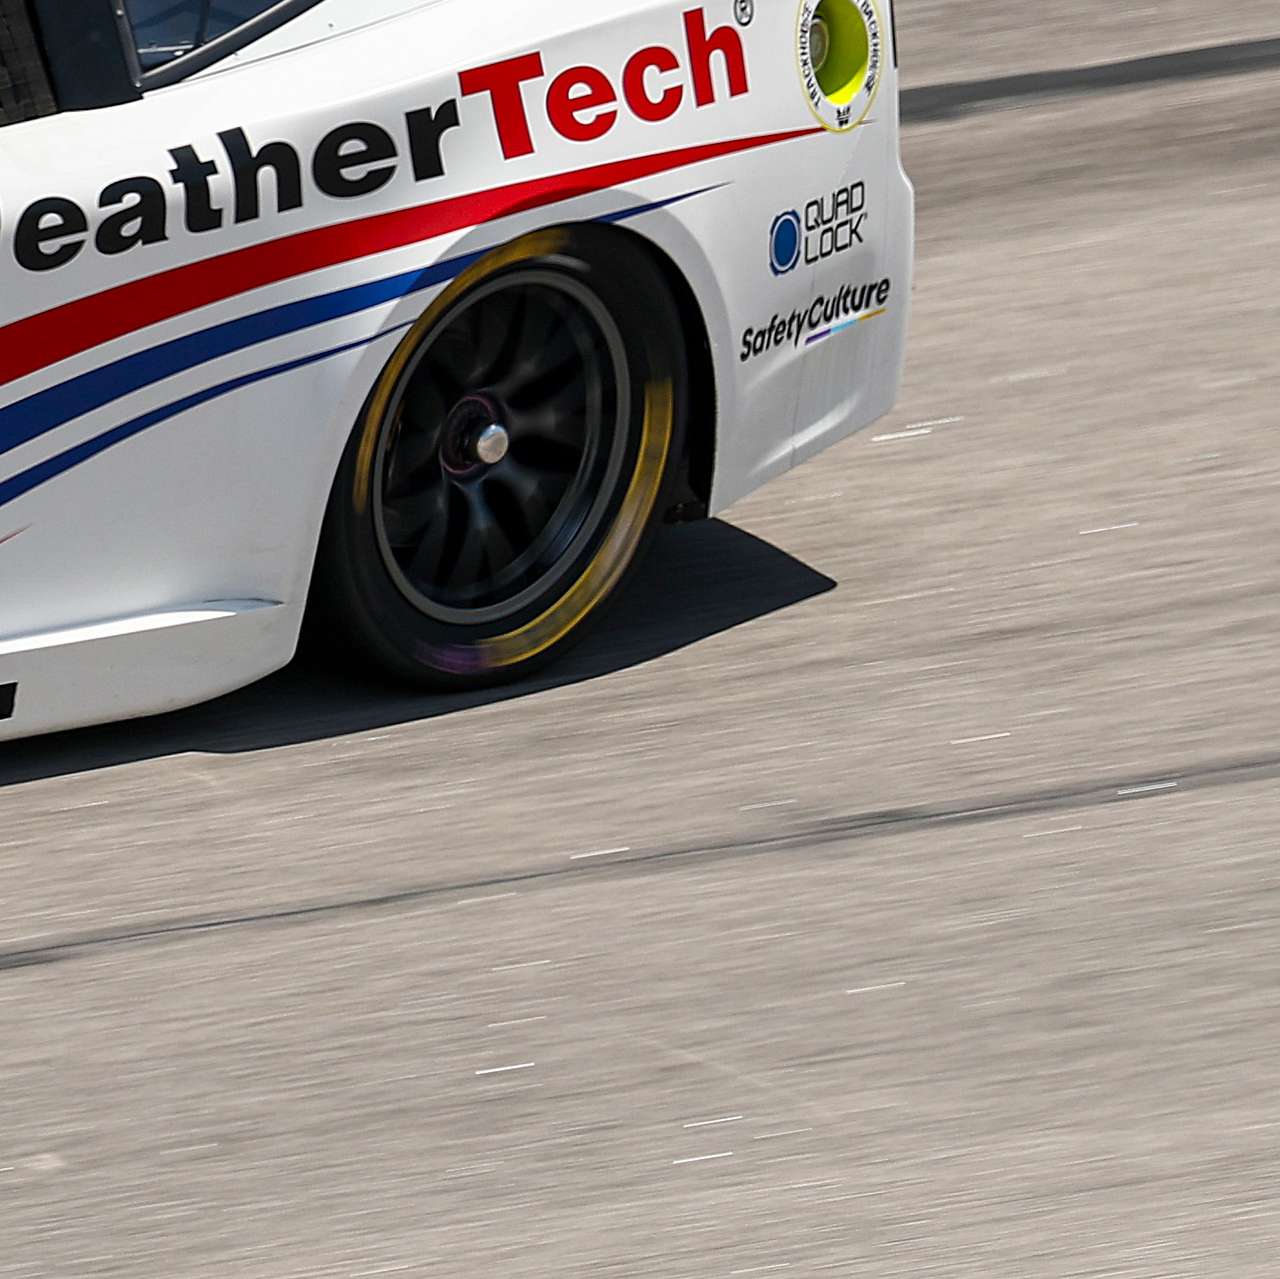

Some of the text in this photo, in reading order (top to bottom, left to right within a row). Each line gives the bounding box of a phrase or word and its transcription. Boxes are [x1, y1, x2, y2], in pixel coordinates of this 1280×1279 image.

[804, 181, 865, 231] QUAD
[804, 213, 864, 265] LOCK
[740, 278, 891, 362] SafetyCulture
